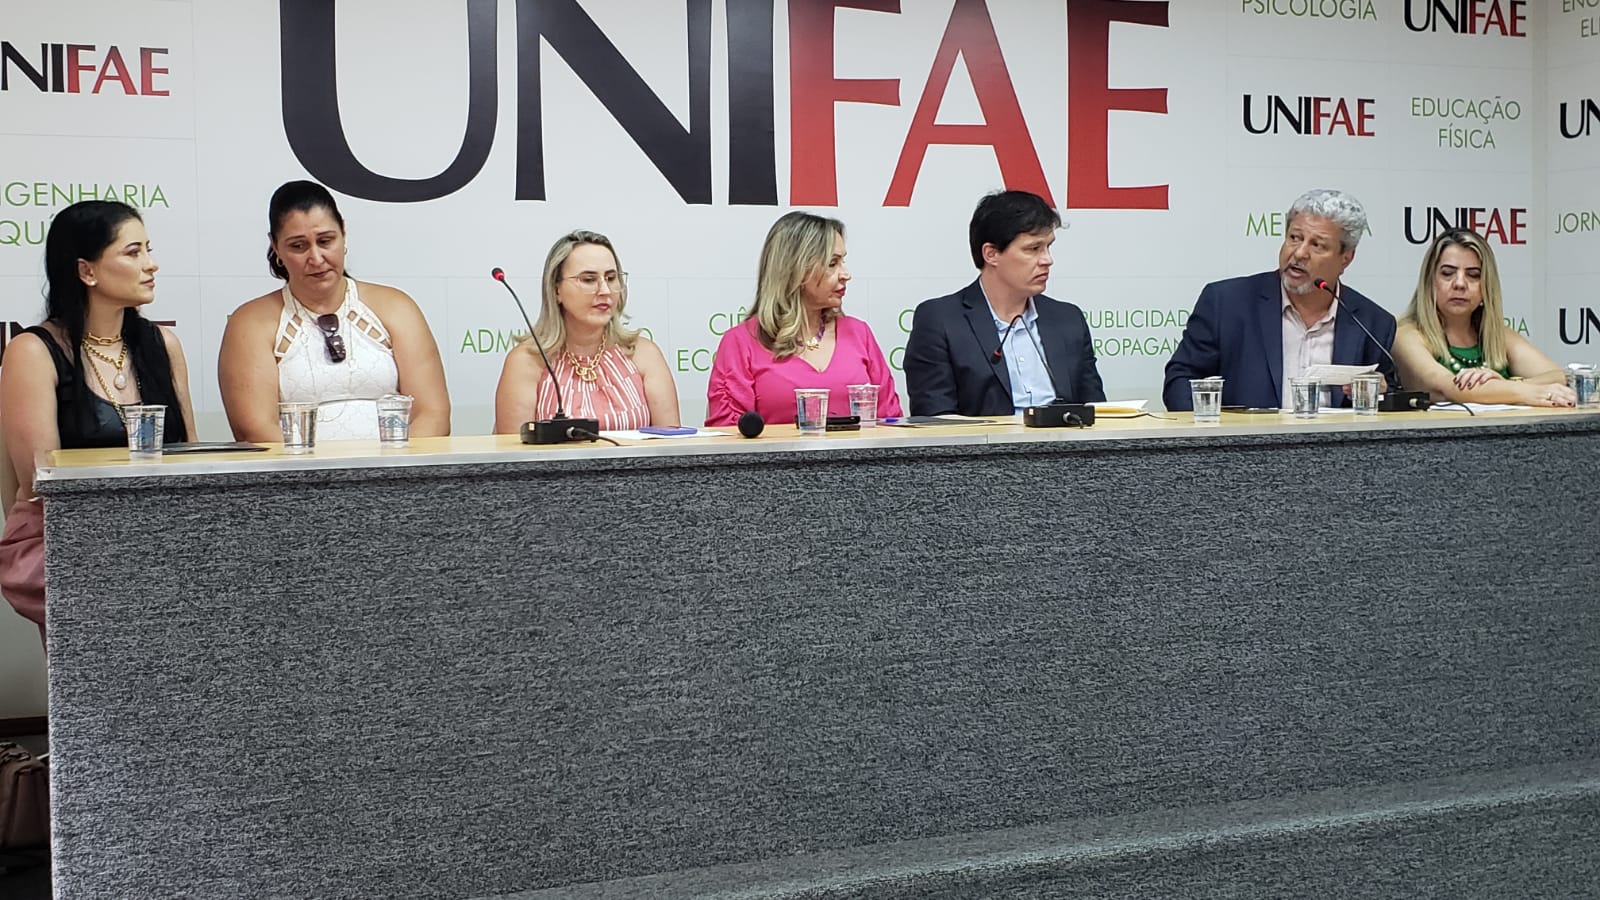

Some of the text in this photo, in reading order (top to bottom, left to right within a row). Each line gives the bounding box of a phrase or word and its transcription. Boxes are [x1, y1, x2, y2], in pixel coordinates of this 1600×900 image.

[1242, 0, 1377, 21] PSICOLOGIA
[1404, 0, 1527, 37] UNIFAE
[279, 0, 1169, 210] UNIFAE
[1243, 94, 1376, 137] UNIFAE
[1411, 96, 1521, 124] EDUCAÇÃO
[1438, 123, 1496, 149] FÍSICA
[0, 182, 169, 208] GENHARIA
[1404, 207, 1527, 244] UNIFAE
